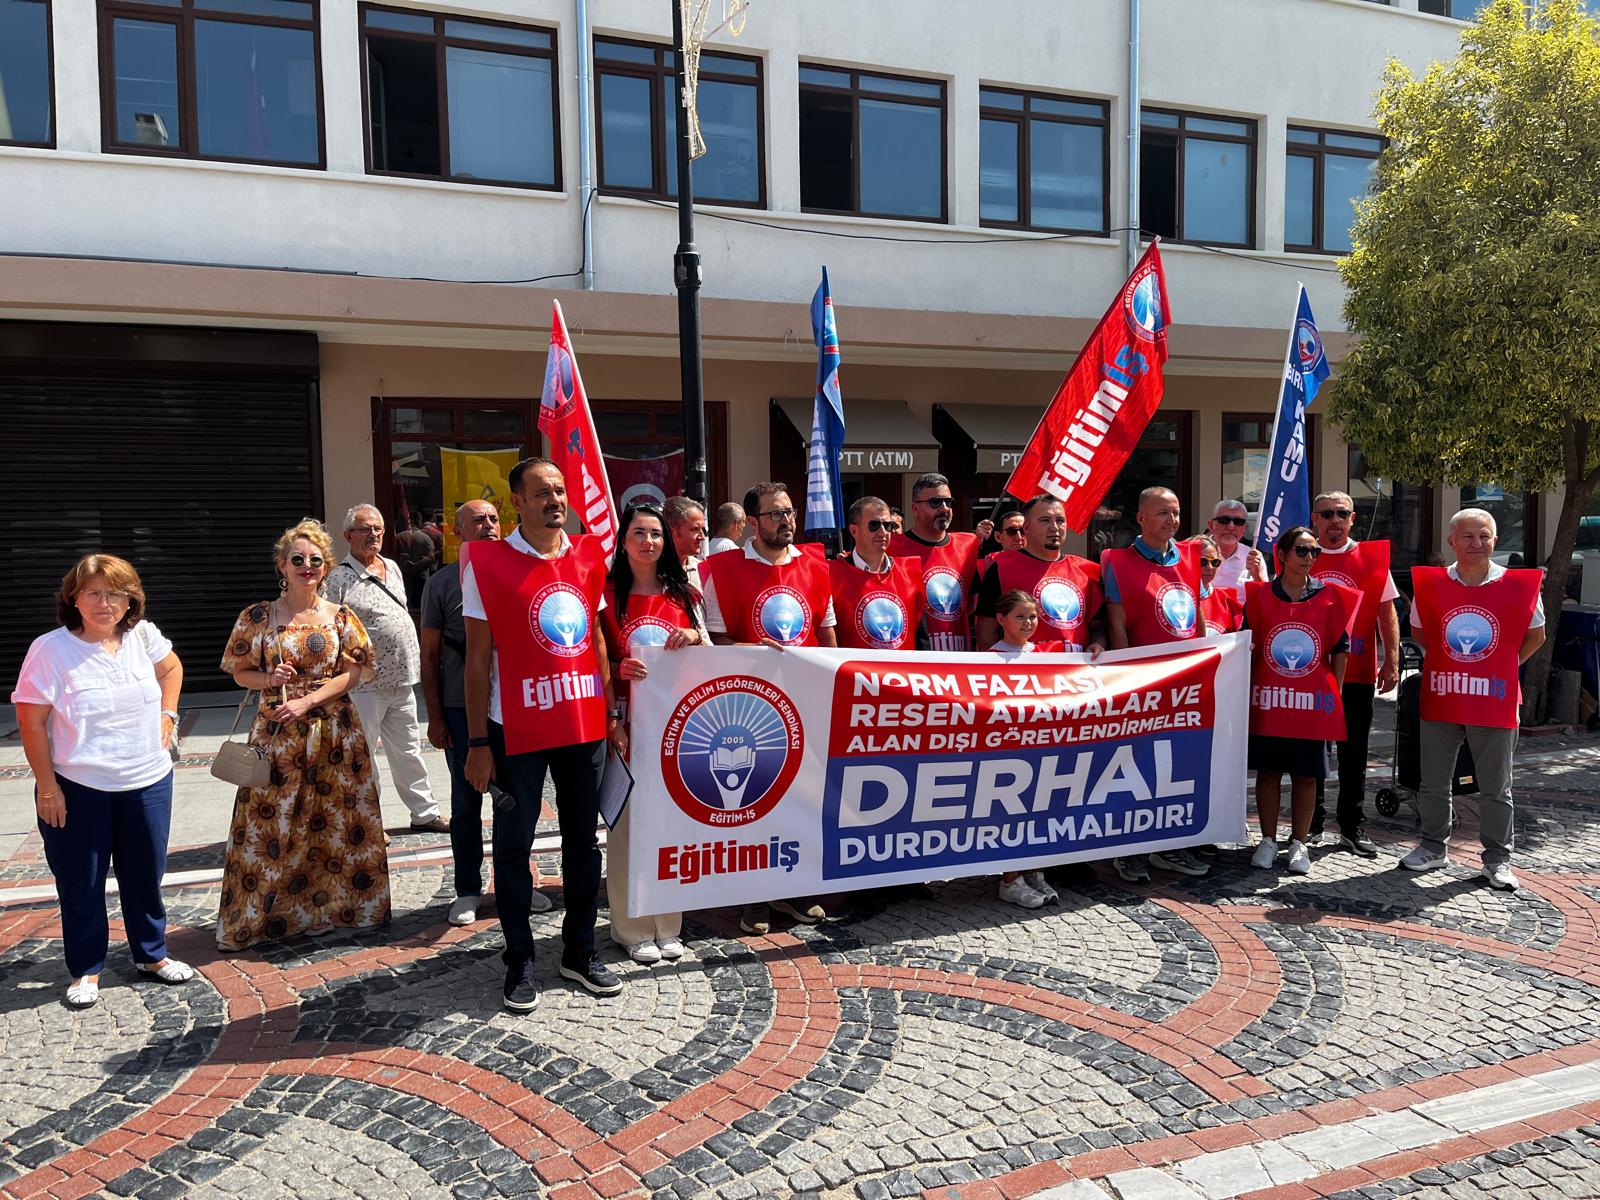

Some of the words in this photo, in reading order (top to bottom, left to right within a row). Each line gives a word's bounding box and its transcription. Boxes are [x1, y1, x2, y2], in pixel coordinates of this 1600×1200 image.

[1038, 344, 1149, 502] Eğitimiş
[1280, 400, 1305, 482] KAMU
[869, 451, 914, 469] (ATM)
[1001, 452, 1023, 467] PT
[1264, 491, 1284, 543] İŞ
[850, 702, 975, 727] RESEN
[987, 691, 1162, 724] ATAMALAR
[1171, 684, 1202, 707] VE
[853, 672, 961, 697] NORM
[1252, 686, 1334, 714] Eğitimiş
[1430, 671, 1506, 700] Eğitimiş
[665, 719, 682, 756] EĞİTİM
[679, 703, 690, 717] VE
[688, 685, 715, 705] BİLİM
[716, 678, 781, 703] İŞGÖRENLERİ
[777, 699, 800, 750] SENDİKASI
[846, 734, 921, 753] ALAN
[929, 732, 978, 752] DIŞI
[985, 711, 1202, 747] GÖREVLENDİRMELER
[721, 736, 745, 745] 2005
[838, 740, 1195, 828] DERHAL
[709, 809, 756, 824] EĞİTİM-İŞ
[839, 803, 1194, 866] DURDURULMALIDIR!
[657, 836, 799, 884] Eğitimiş
